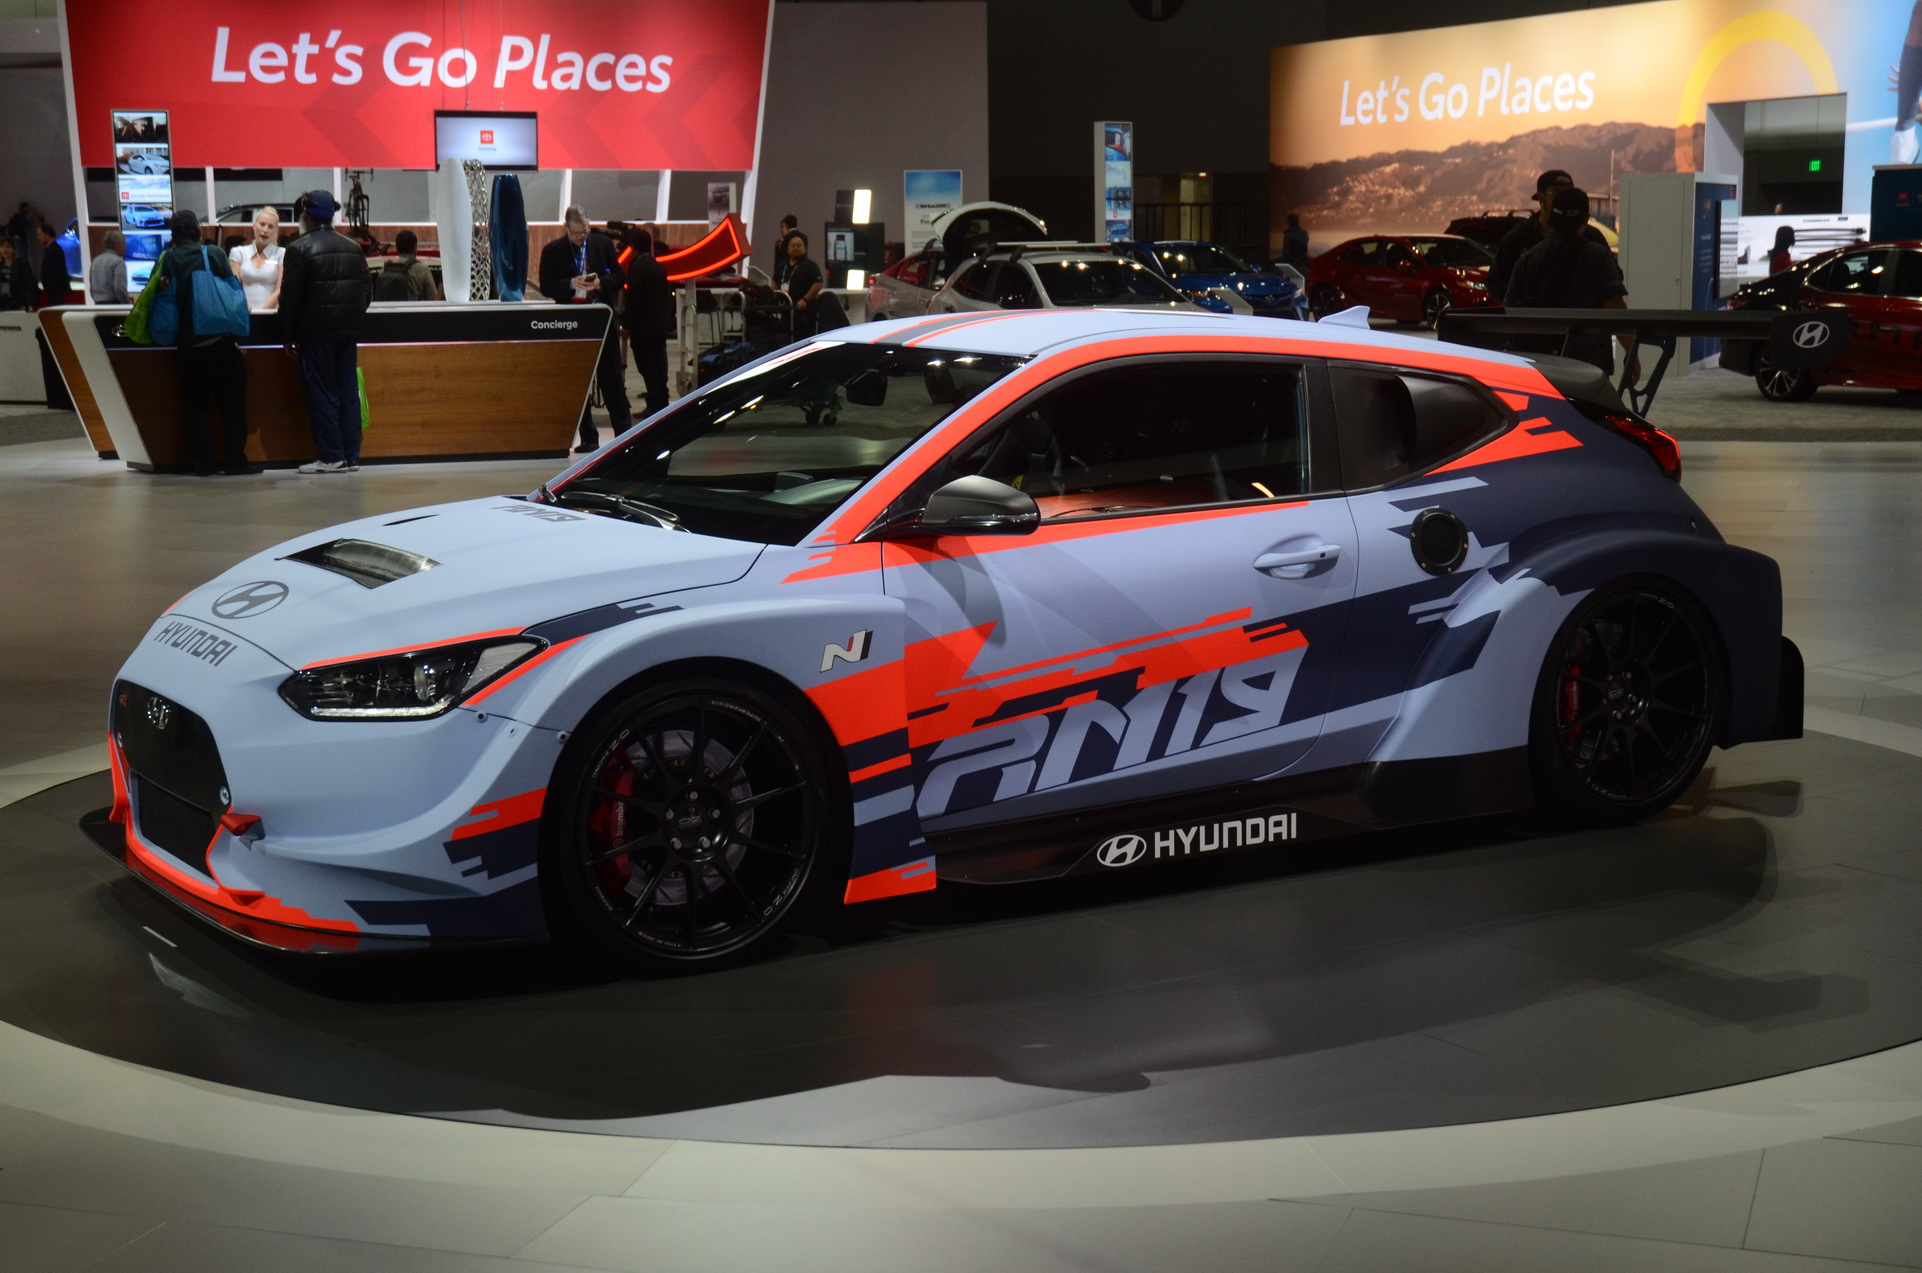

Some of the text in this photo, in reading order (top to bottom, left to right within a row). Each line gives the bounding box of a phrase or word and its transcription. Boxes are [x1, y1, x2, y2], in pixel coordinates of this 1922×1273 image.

[211, 26, 674, 93] Let's Go Places
[1339, 62, 1596, 127] Let's Go Places
[530, 319, 578, 331] Concierge
[154, 620, 238, 667] HYUNDAI
[1154, 812, 1298, 859] HYUNDAI
